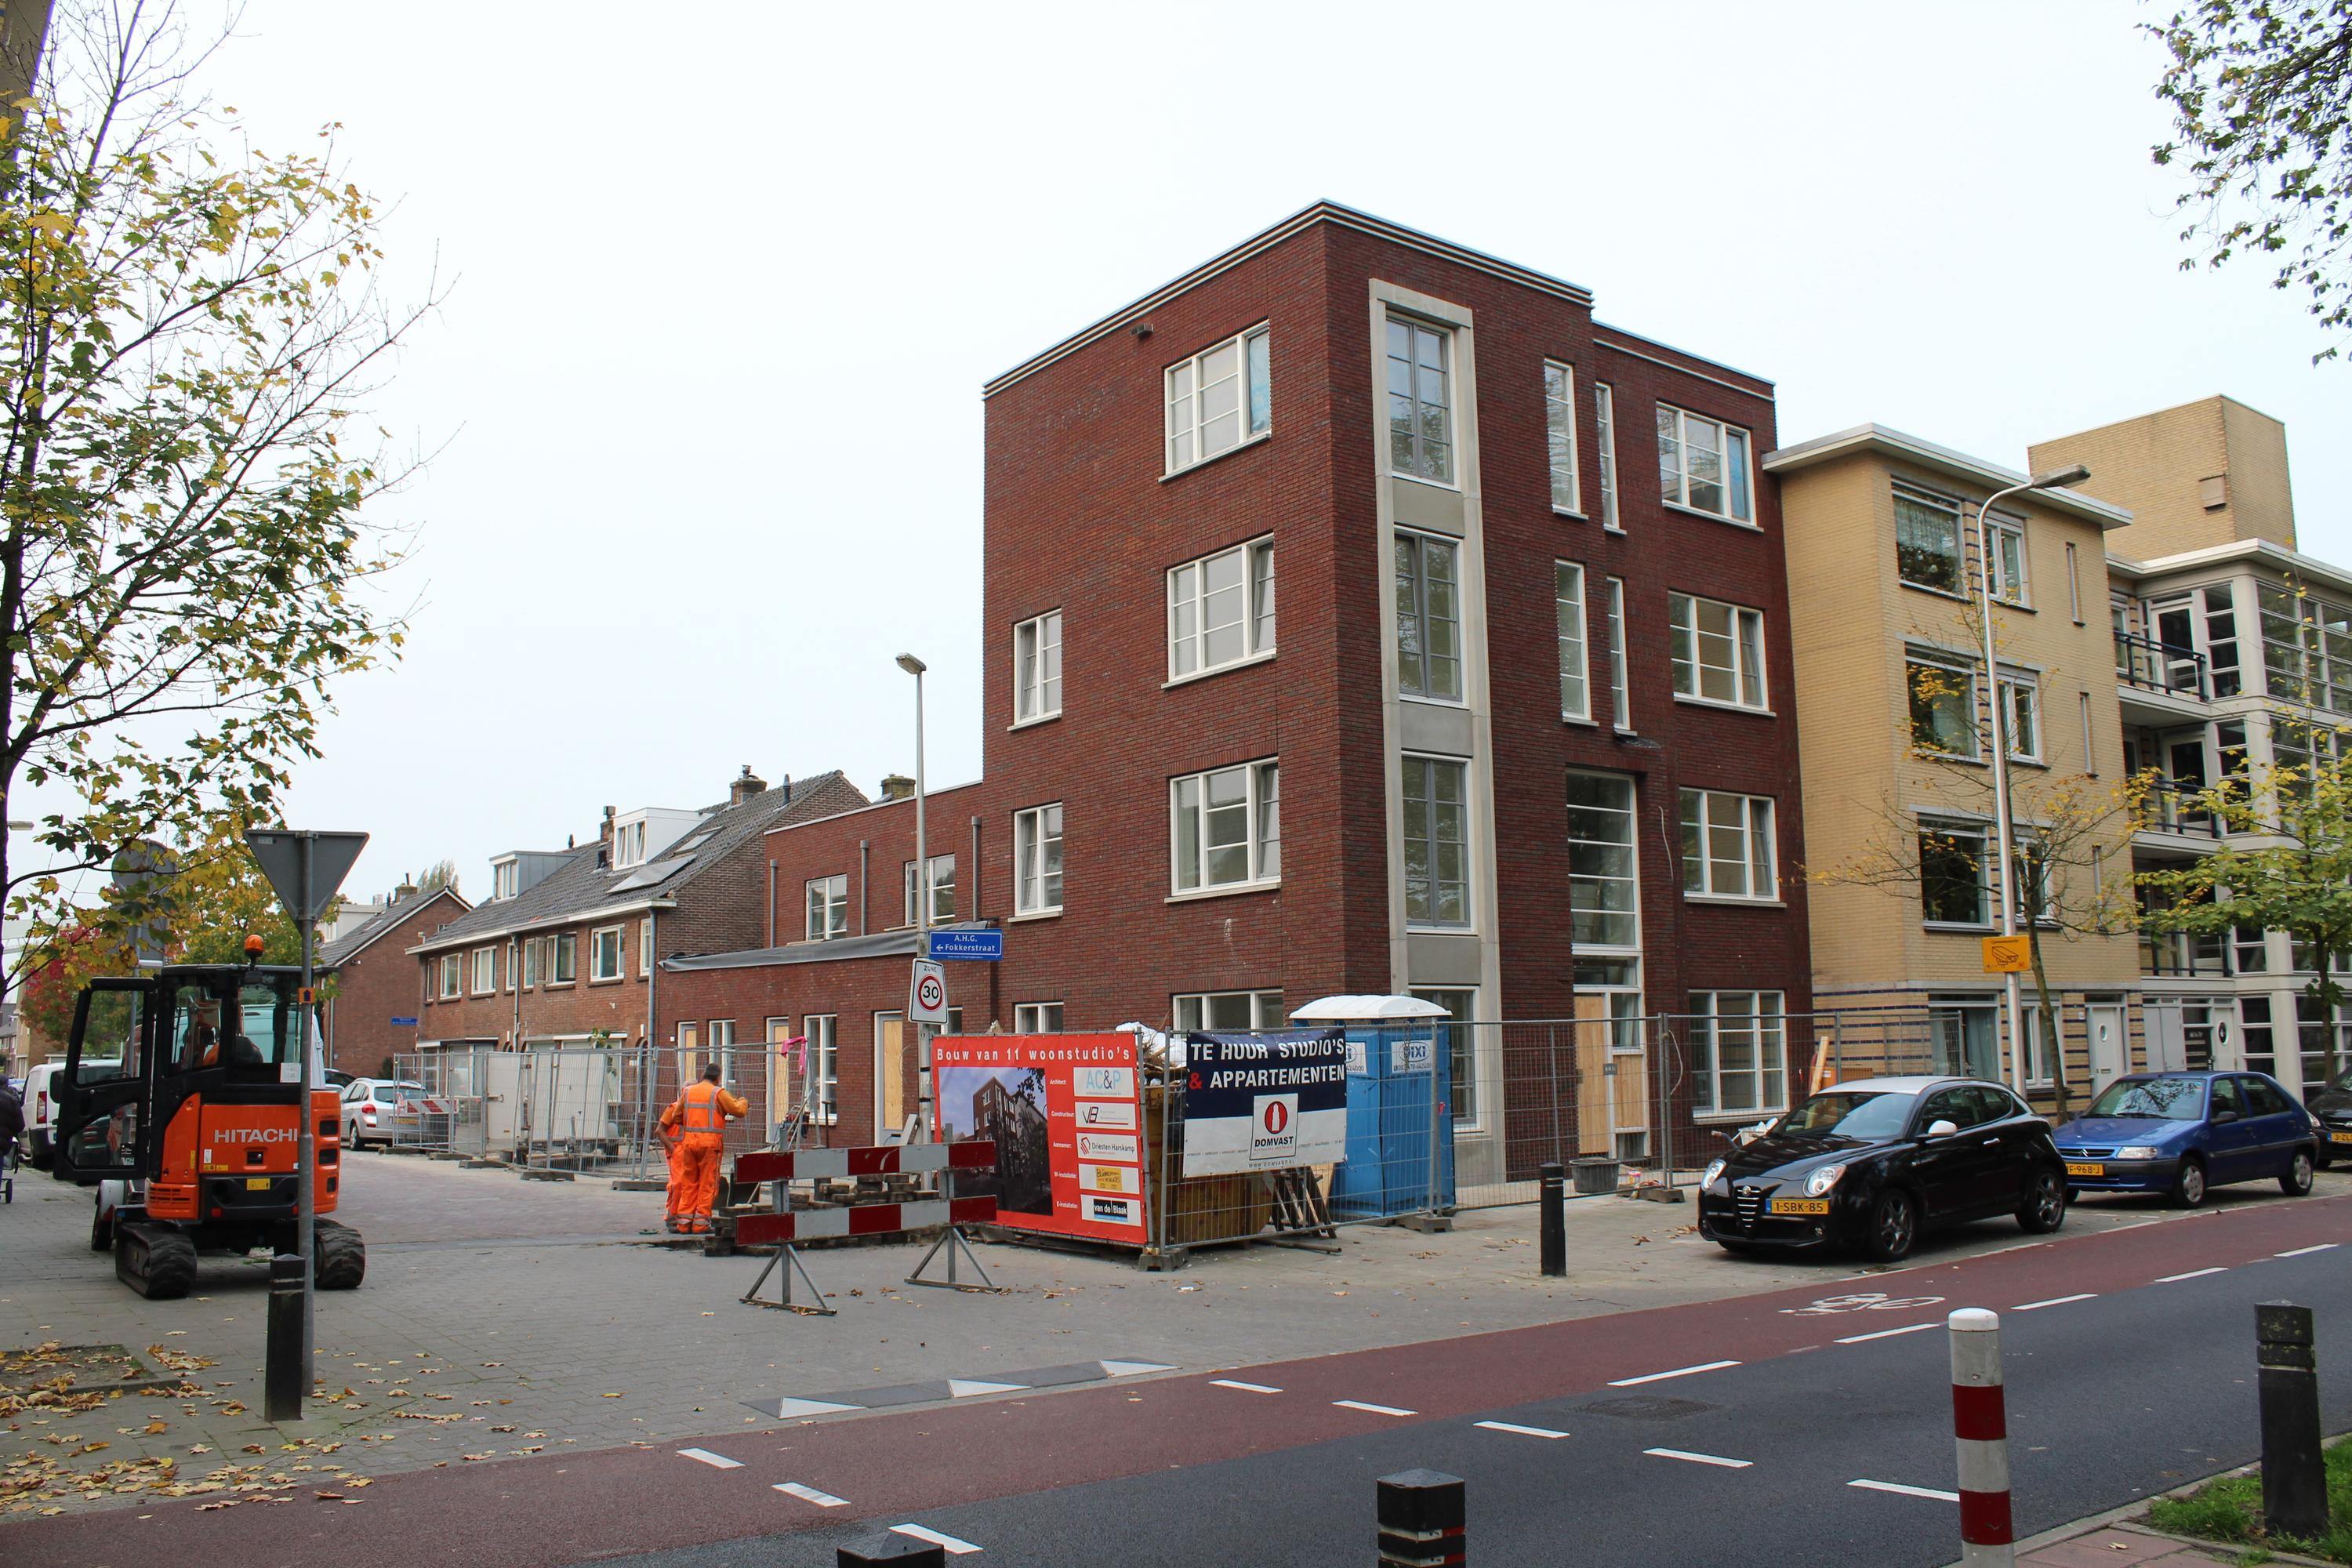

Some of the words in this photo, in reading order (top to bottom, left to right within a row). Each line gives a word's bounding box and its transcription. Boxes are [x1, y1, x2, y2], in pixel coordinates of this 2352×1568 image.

[945, 943, 996, 952] Fokkerstraat
[923, 985, 939, 999] 30
[937, 1048, 970, 1061] Bouw
[977, 1051, 999, 1061] van
[1006, 1047, 1019, 1061] 11
[1029, 1047, 1130, 1061] woonstudio's
[1190, 1044, 1213, 1061] TE
[1220, 1043, 1269, 1061] HUUR
[1279, 1038, 1345, 1058] STUDIO'S
[1086, 1070, 1121, 1089] AC&P
[1189, 1072, 1203, 1090] &
[1210, 1063, 1345, 1089] APPARTEMENTEN
[214, 1128, 298, 1143] HITACHI
[1254, 1136, 1294, 1147] DOMVAST
[1112, 1143, 1135, 1153] Harskamp
[2067, 1165, 2100, 1174] F-968-J
[1104, 1204, 1111, 1214] de
[1112, 1205, 1127, 1215] Blaak
[1776, 1202, 1824, 1212] 1-SBK-85
